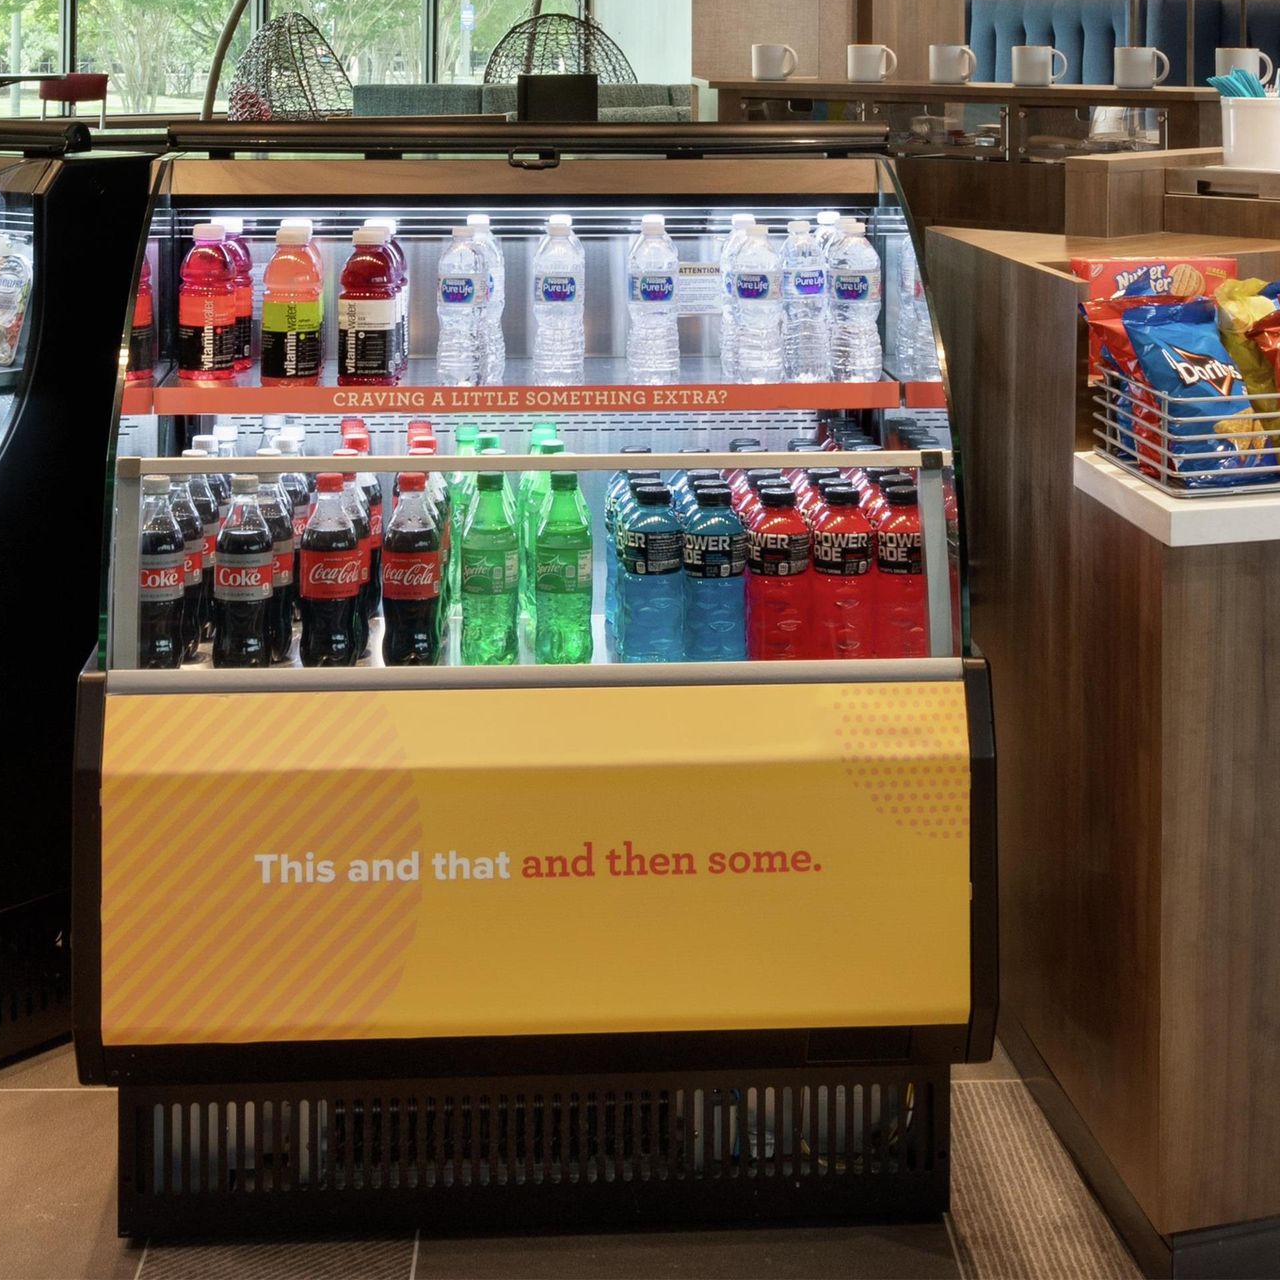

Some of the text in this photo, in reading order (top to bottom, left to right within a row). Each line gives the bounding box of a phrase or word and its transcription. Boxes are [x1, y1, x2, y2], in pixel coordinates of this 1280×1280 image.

[641, 283, 673, 294] Pure Life
[737, 280, 769, 292] Pure Life
[795, 277, 813, 285] Pure
[835, 281, 868, 293] Pure Life
[442, 284, 473, 297] Pure Life
[544, 283, 575, 296] Pure Life
[284, 305, 297, 376] vitaminwater
[346, 303, 357, 374] vitaminwater
[1176, 356, 1242, 384] Doritos
[333, 390, 728, 408] CRAVING A LITTLE SOMETHING EXTRA?
[814, 532, 868, 548] POWER
[220, 568, 261, 586] Coke
[536, 563, 563, 578] Sprite
[140, 570, 179, 588] Coke
[254, 840, 822, 887] This and that and then some.
